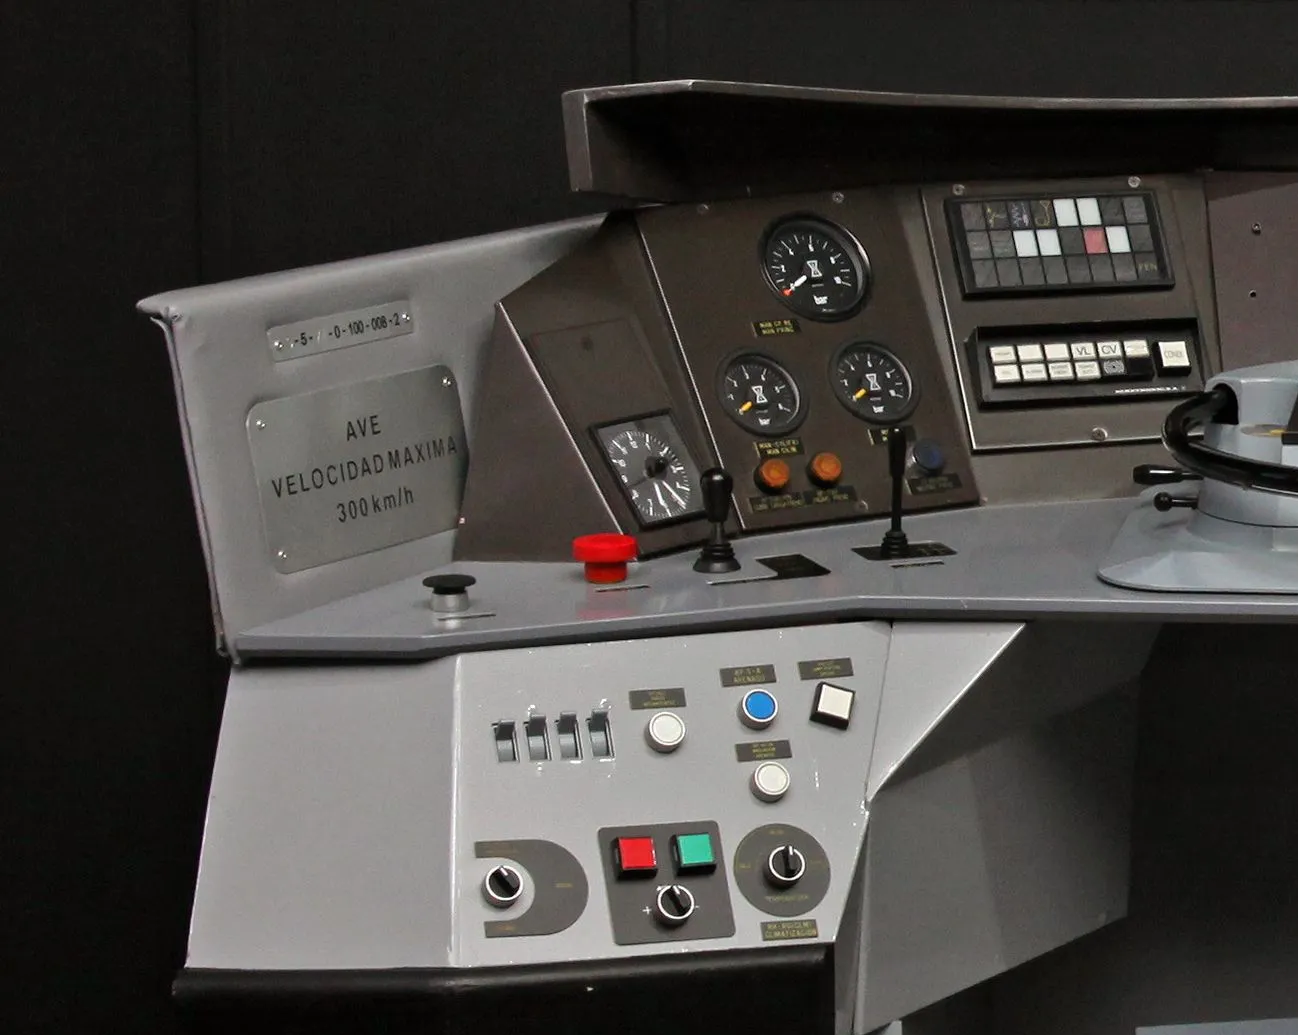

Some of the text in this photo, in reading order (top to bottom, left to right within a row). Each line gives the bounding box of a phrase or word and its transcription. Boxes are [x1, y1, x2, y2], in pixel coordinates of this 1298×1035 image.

[1076, 347, 1090, 356] VL
[1100, 345, 1117, 355] CV
[346, 415, 381, 441] AVE
[272, 435, 458, 498] VELOCIDAD MAXIMA
[337, 486, 414, 523] 300 km/h
